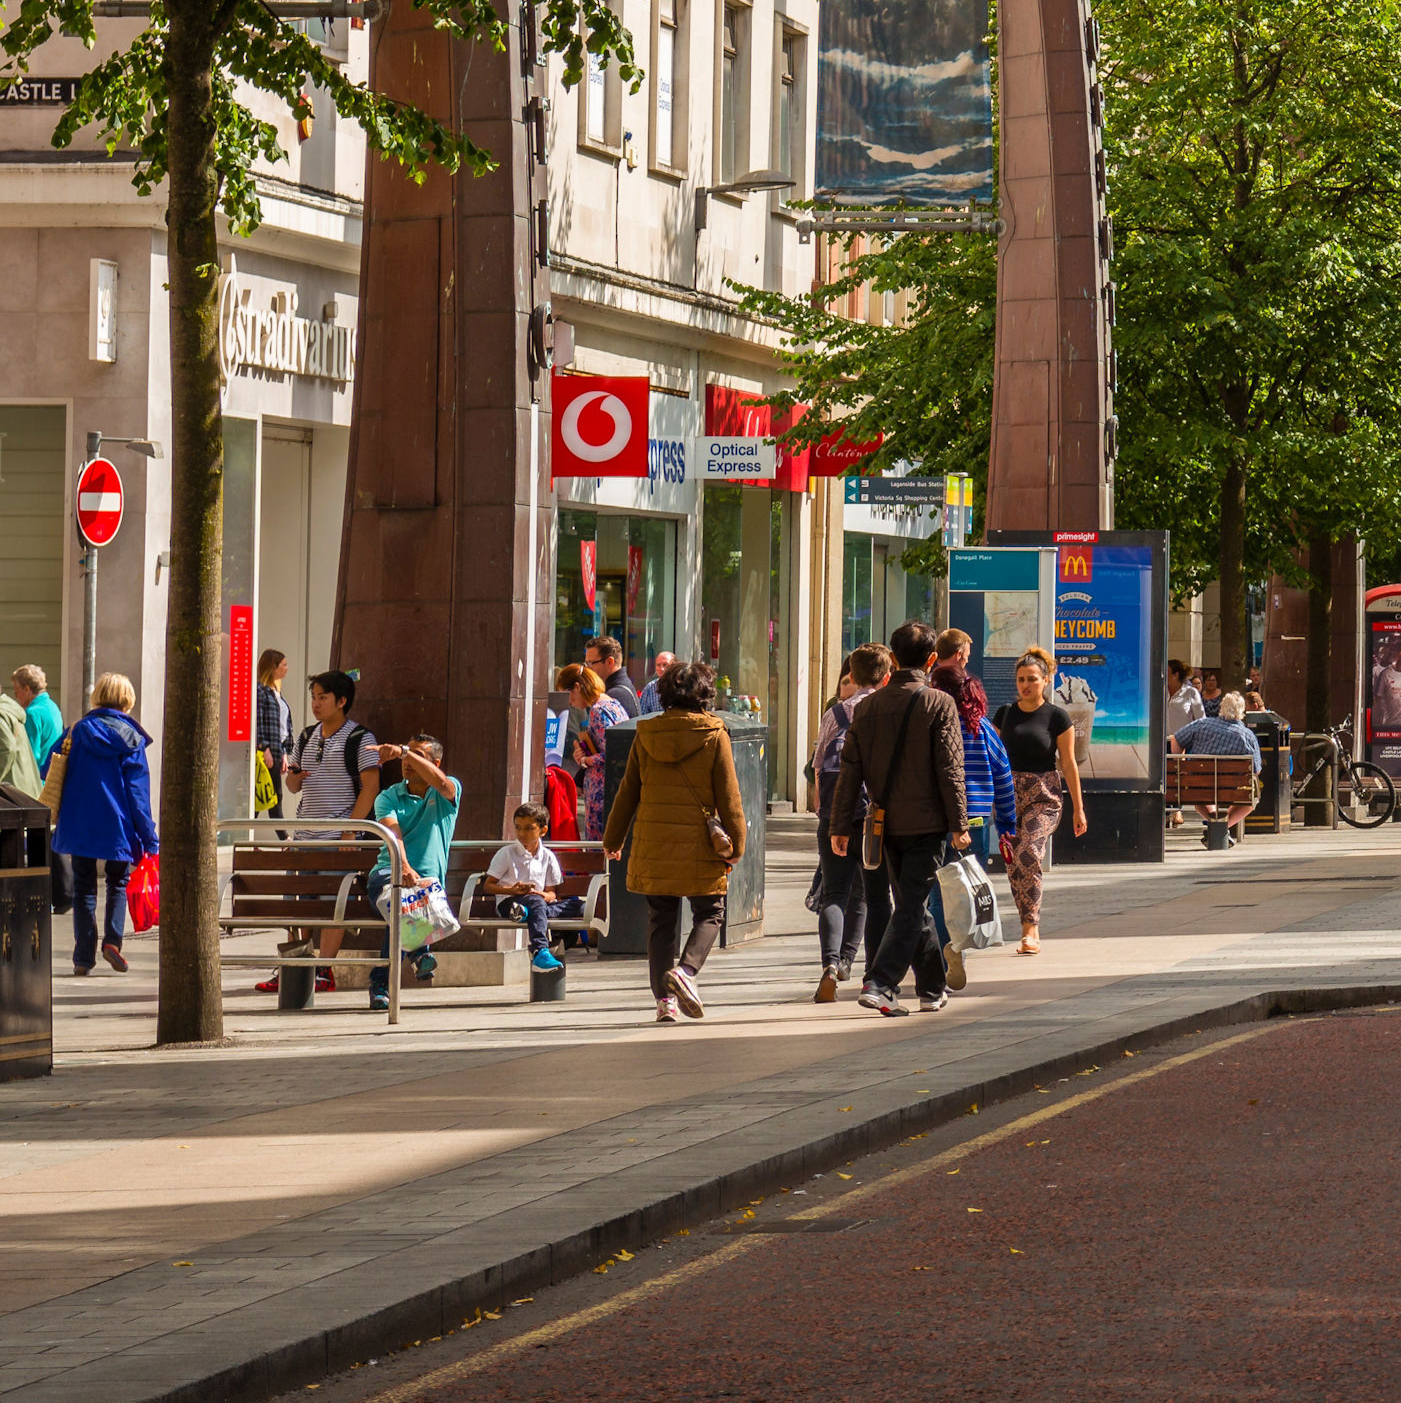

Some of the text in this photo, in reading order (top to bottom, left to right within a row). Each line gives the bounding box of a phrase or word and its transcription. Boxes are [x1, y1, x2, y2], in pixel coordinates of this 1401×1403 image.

[0, 83, 61, 100] ASTLE
[710, 443, 758, 459] Optical
[648, 438, 685, 494] press
[707, 460, 762, 475] Express
[1056, 532, 1095, 541] primesight
[1055, 620, 1116, 639] NEYCOMB
[547, 722, 558, 734] JW
